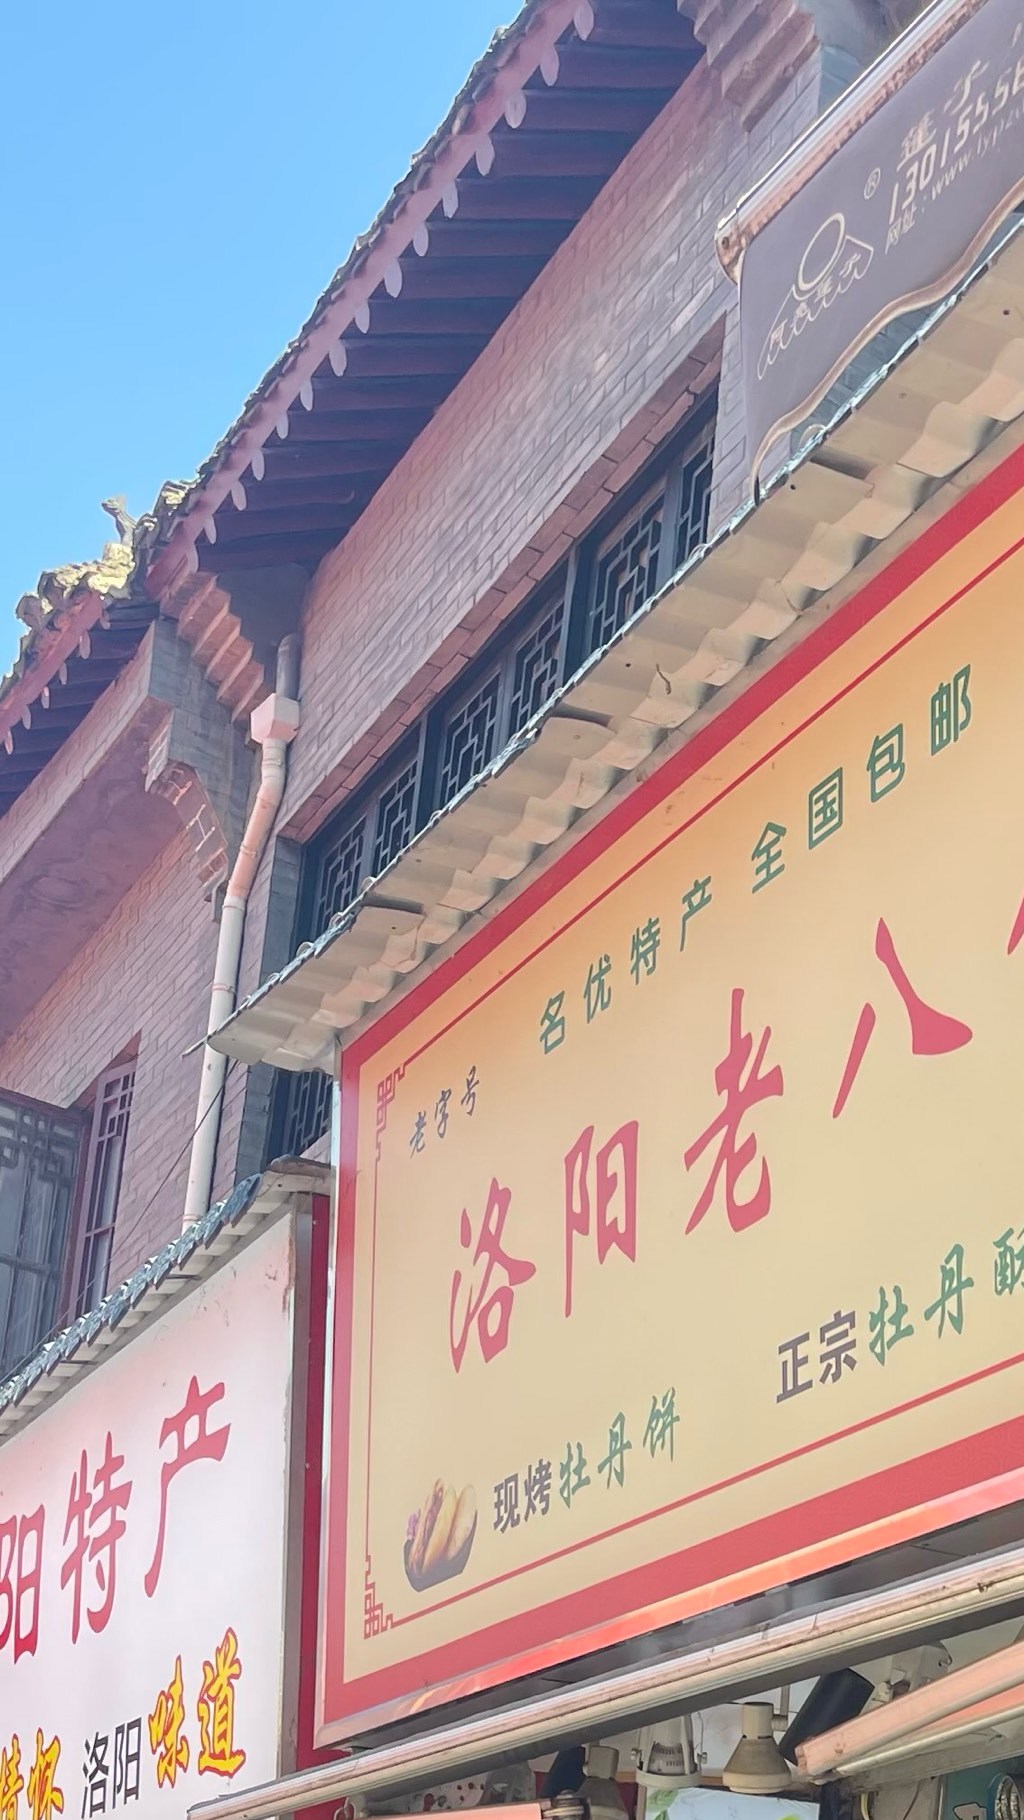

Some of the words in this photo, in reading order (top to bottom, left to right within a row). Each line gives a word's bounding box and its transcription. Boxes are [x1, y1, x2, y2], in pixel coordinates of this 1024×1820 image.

[538, 877, 713, 1056] 名优特产
[751, 663, 972, 894] 全国包邮
[408, 1064, 481, 1159] 老字号
[491, 1385, 682, 1535] 现烤牡丹饼
